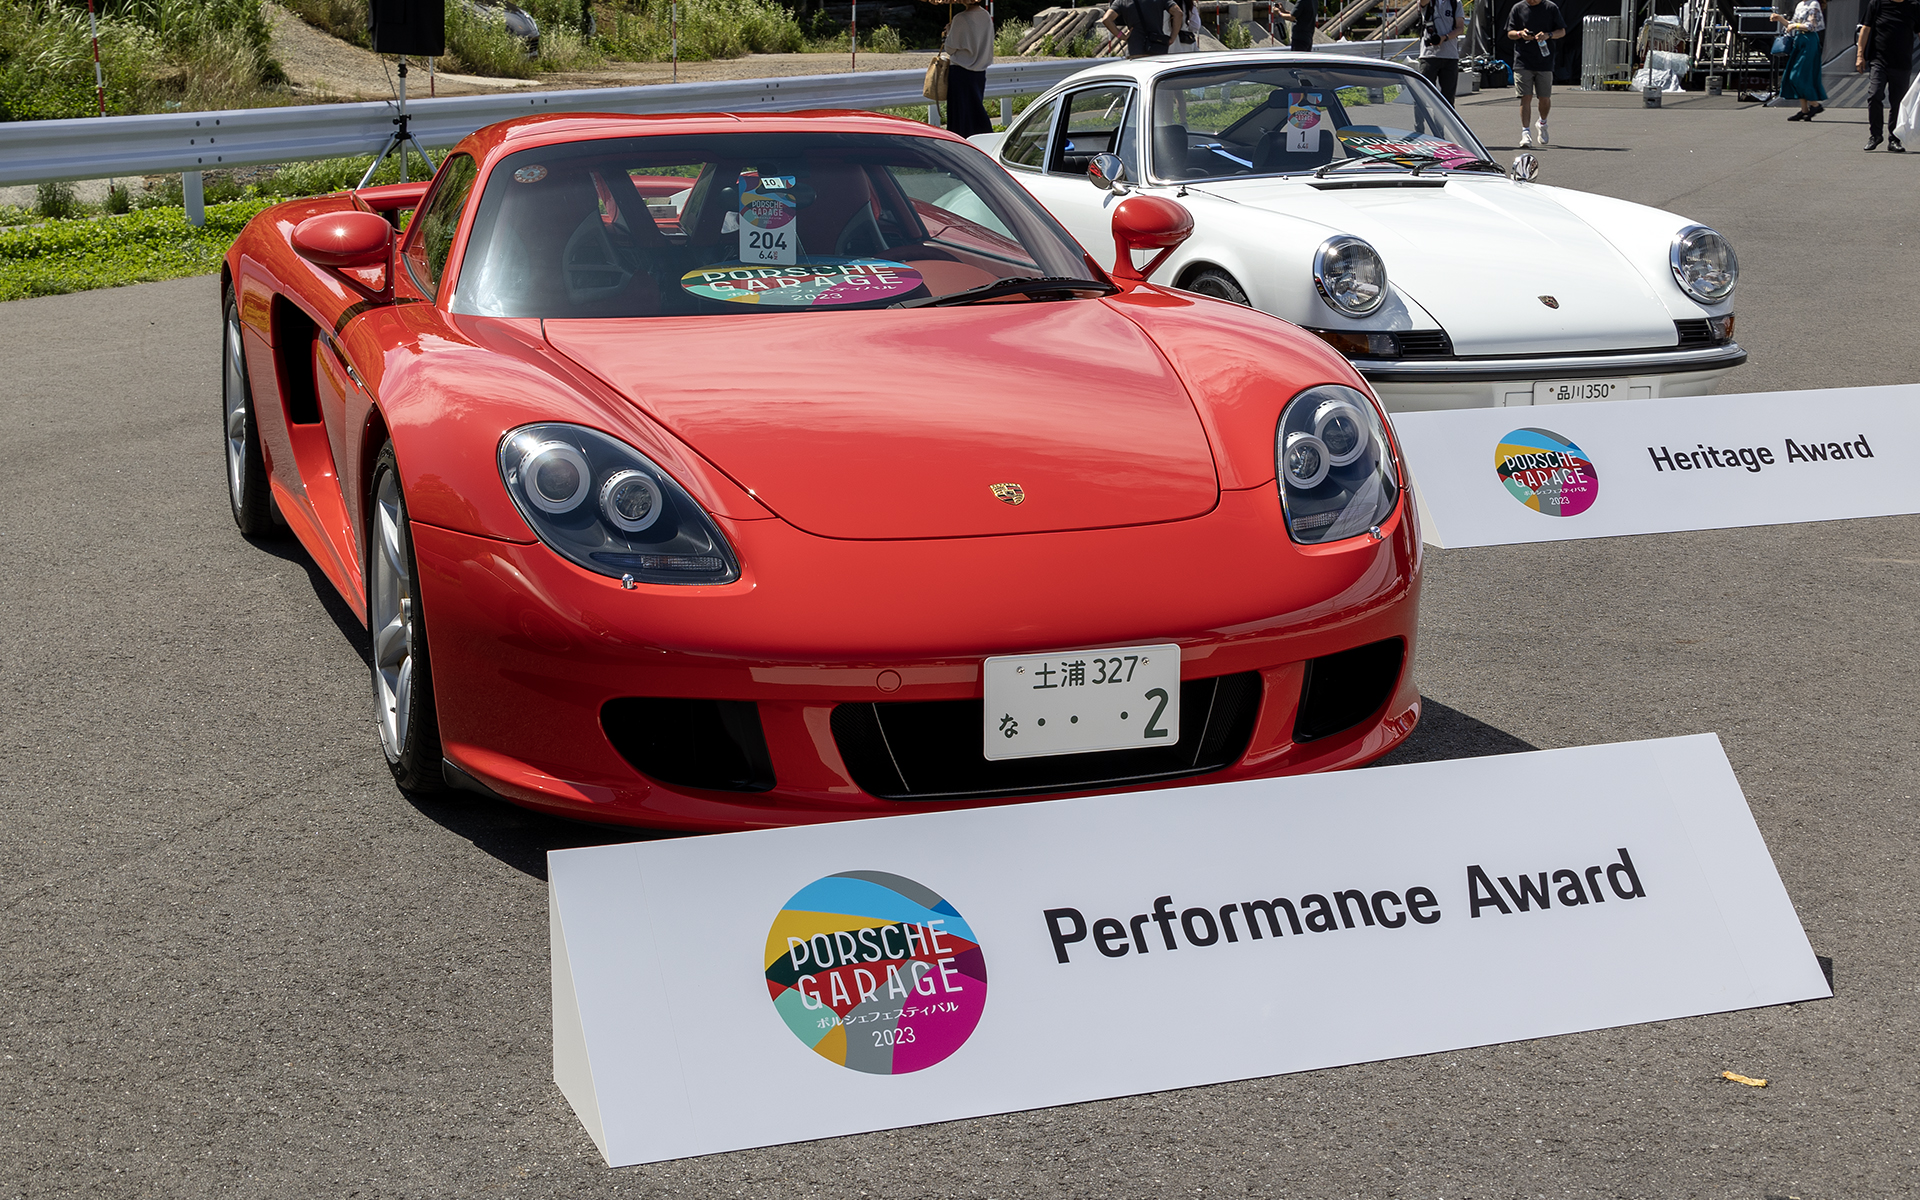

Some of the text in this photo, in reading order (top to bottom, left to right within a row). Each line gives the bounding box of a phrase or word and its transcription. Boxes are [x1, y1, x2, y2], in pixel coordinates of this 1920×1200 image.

[1300, 130, 1305, 142] 1
[752, 200, 783, 209] PORSCHE
[752, 208, 783, 216] GARAGE
[749, 231, 787, 250] 204
[701, 263, 894, 283] PORSCHE
[709, 273, 904, 292] GARAGE
[1503, 451, 1580, 471] PORSCHE
[1647, 434, 1874, 473] Heritage Award
[1511, 467, 1587, 488] GARAGE
[1549, 496, 1570, 505] 2023
[1043, 847, 1646, 965] Performance Award
[787, 919, 953, 971] PORSCHE
[797, 957, 963, 1011] GARAGE
[816, 1001, 959, 1029] ポルシェフェスティバル
[872, 1026, 916, 1048] 2023
